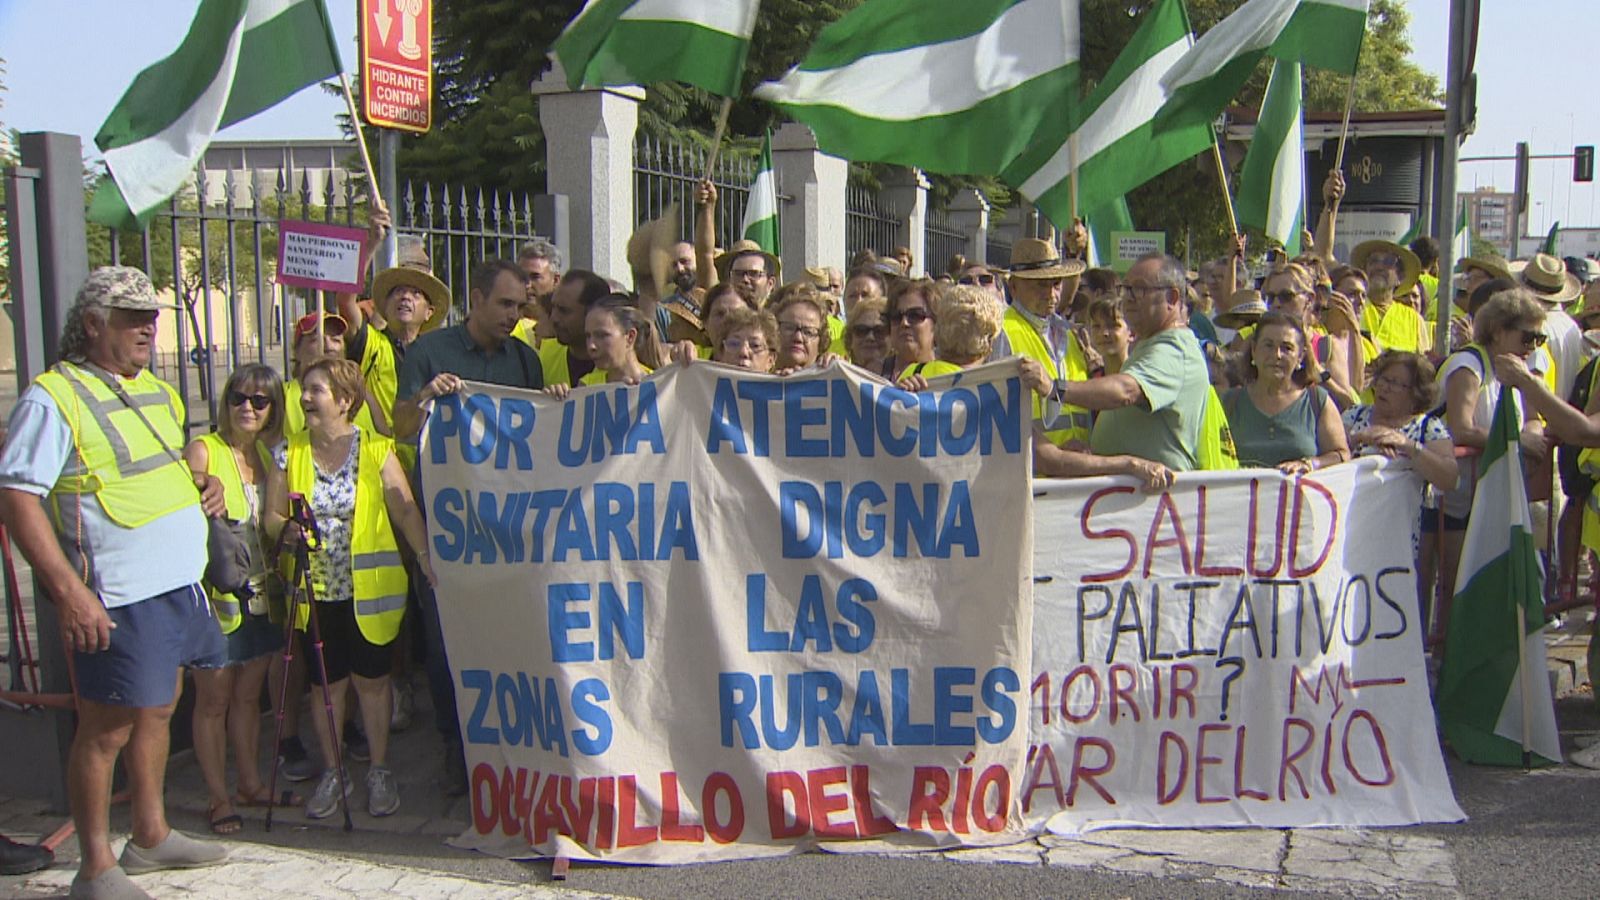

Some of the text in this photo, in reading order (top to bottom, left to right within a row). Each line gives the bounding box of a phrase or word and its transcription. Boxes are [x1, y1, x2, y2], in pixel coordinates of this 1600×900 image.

[370, 101, 427, 124] INCENDIOS
[372, 67, 425, 92] HIDRANTE
[376, 85, 421, 107] CONTRA
[286, 255, 319, 266] MENOS
[286, 266, 325, 278] EXCUSAS
[287, 245, 343, 260] SANITARIO Y
[308, 237, 358, 251] PERSONAL
[429, 381, 666, 471] POR UNA
[706, 372, 1021, 458] ATENCIÓN
[433, 479, 980, 564] SANITARIA DIGNA
[1080, 477, 1338, 583] SALUD
[548, 573, 878, 663] EN LAS
[1077, 567, 1411, 664] PALIATIVOS
[461, 667, 1020, 757] ZONAS RURALES
[1157, 723, 1269, 805] DEL
[1278, 701, 1395, 802] RÍO
[472, 751, 1011, 850] OCHAVILLO DEL RÍO
